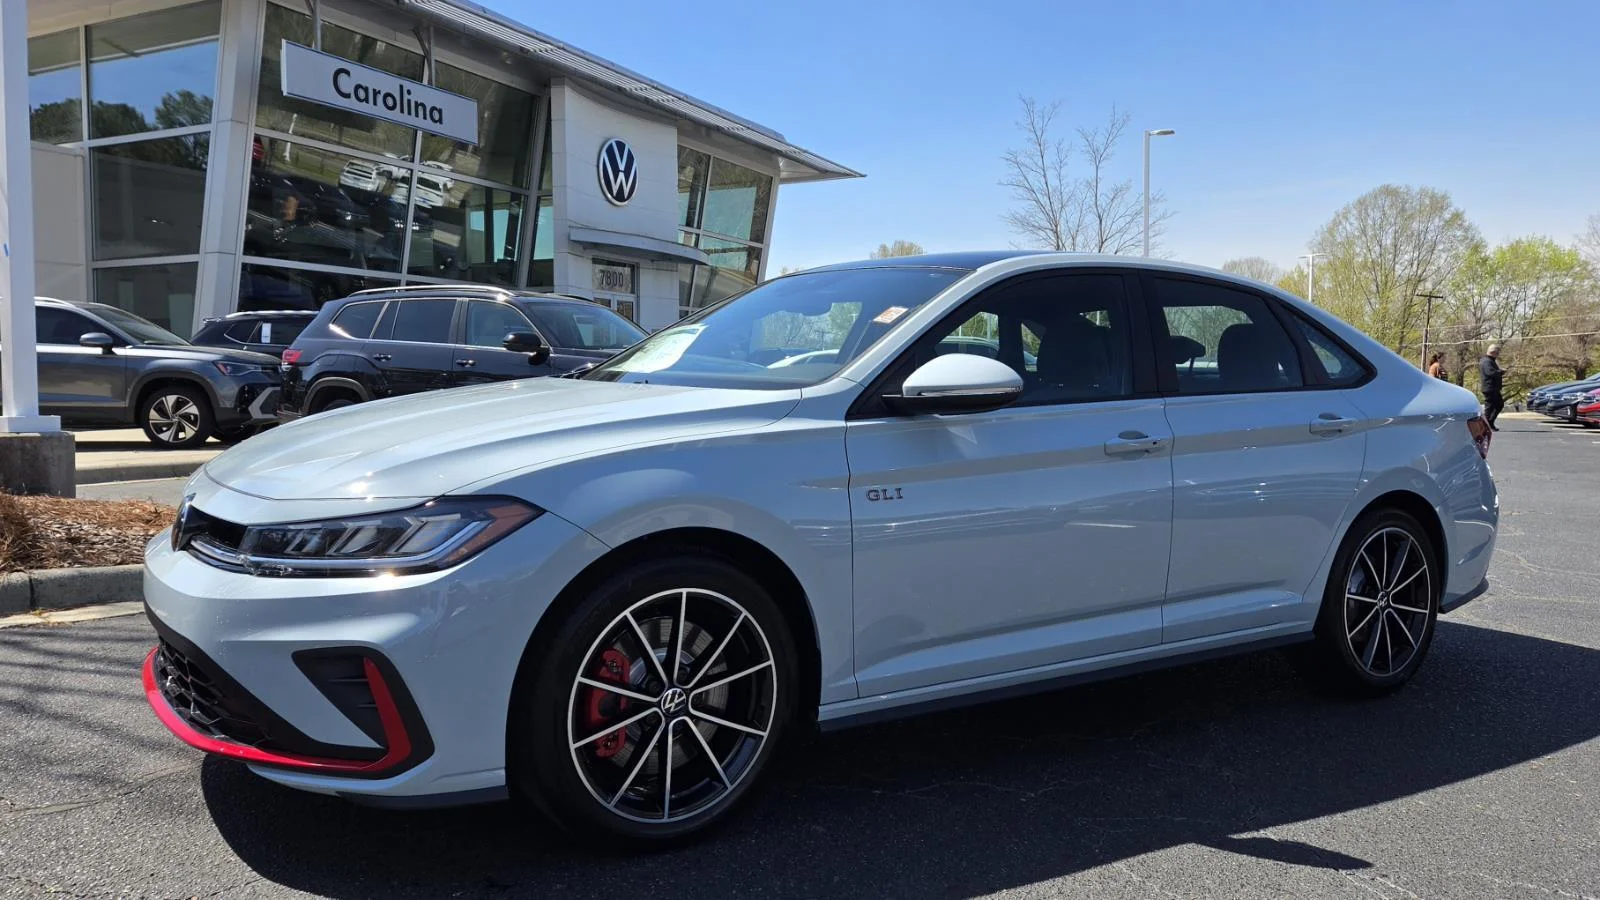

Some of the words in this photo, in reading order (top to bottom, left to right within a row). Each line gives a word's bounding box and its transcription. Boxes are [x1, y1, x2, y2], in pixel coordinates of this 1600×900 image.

[332, 67, 443, 125] Carolina
[601, 140, 638, 202] VW
[600, 269, 623, 288] 7800
[866, 487, 904, 501] GLI
